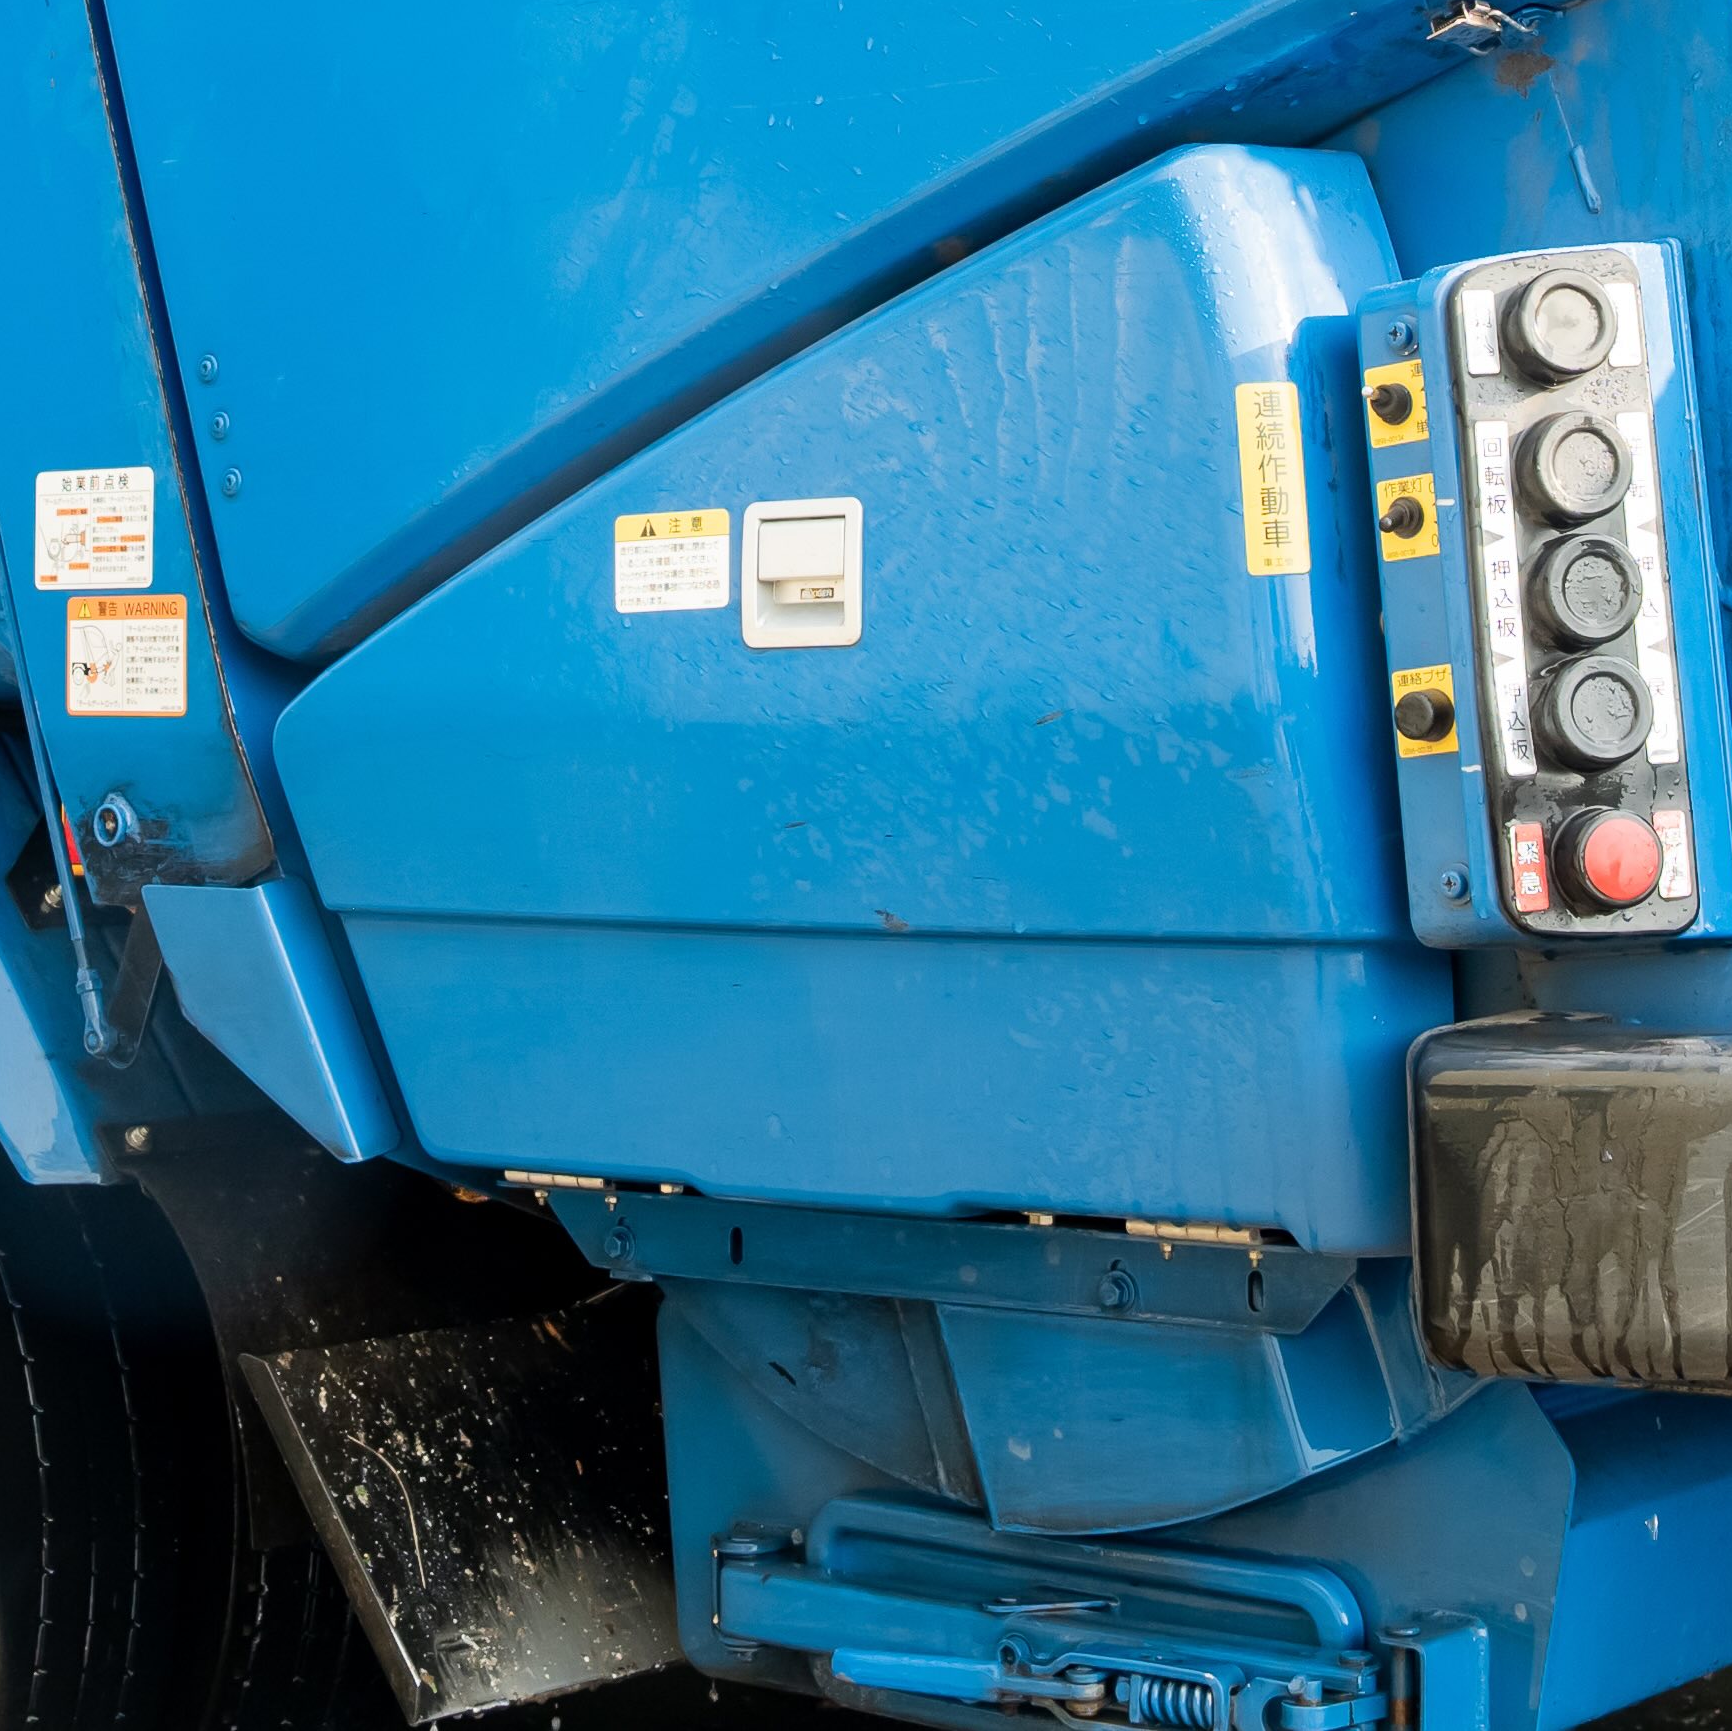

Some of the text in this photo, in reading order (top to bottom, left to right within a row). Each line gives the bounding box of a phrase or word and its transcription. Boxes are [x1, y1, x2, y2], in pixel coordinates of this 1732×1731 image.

[1254, 390, 1294, 548] 連続作動車
[1384, 477, 1423, 498] 作業灯
[668, 515, 704, 534] 注意
[98, 601, 178, 617] 警告 WARNING
